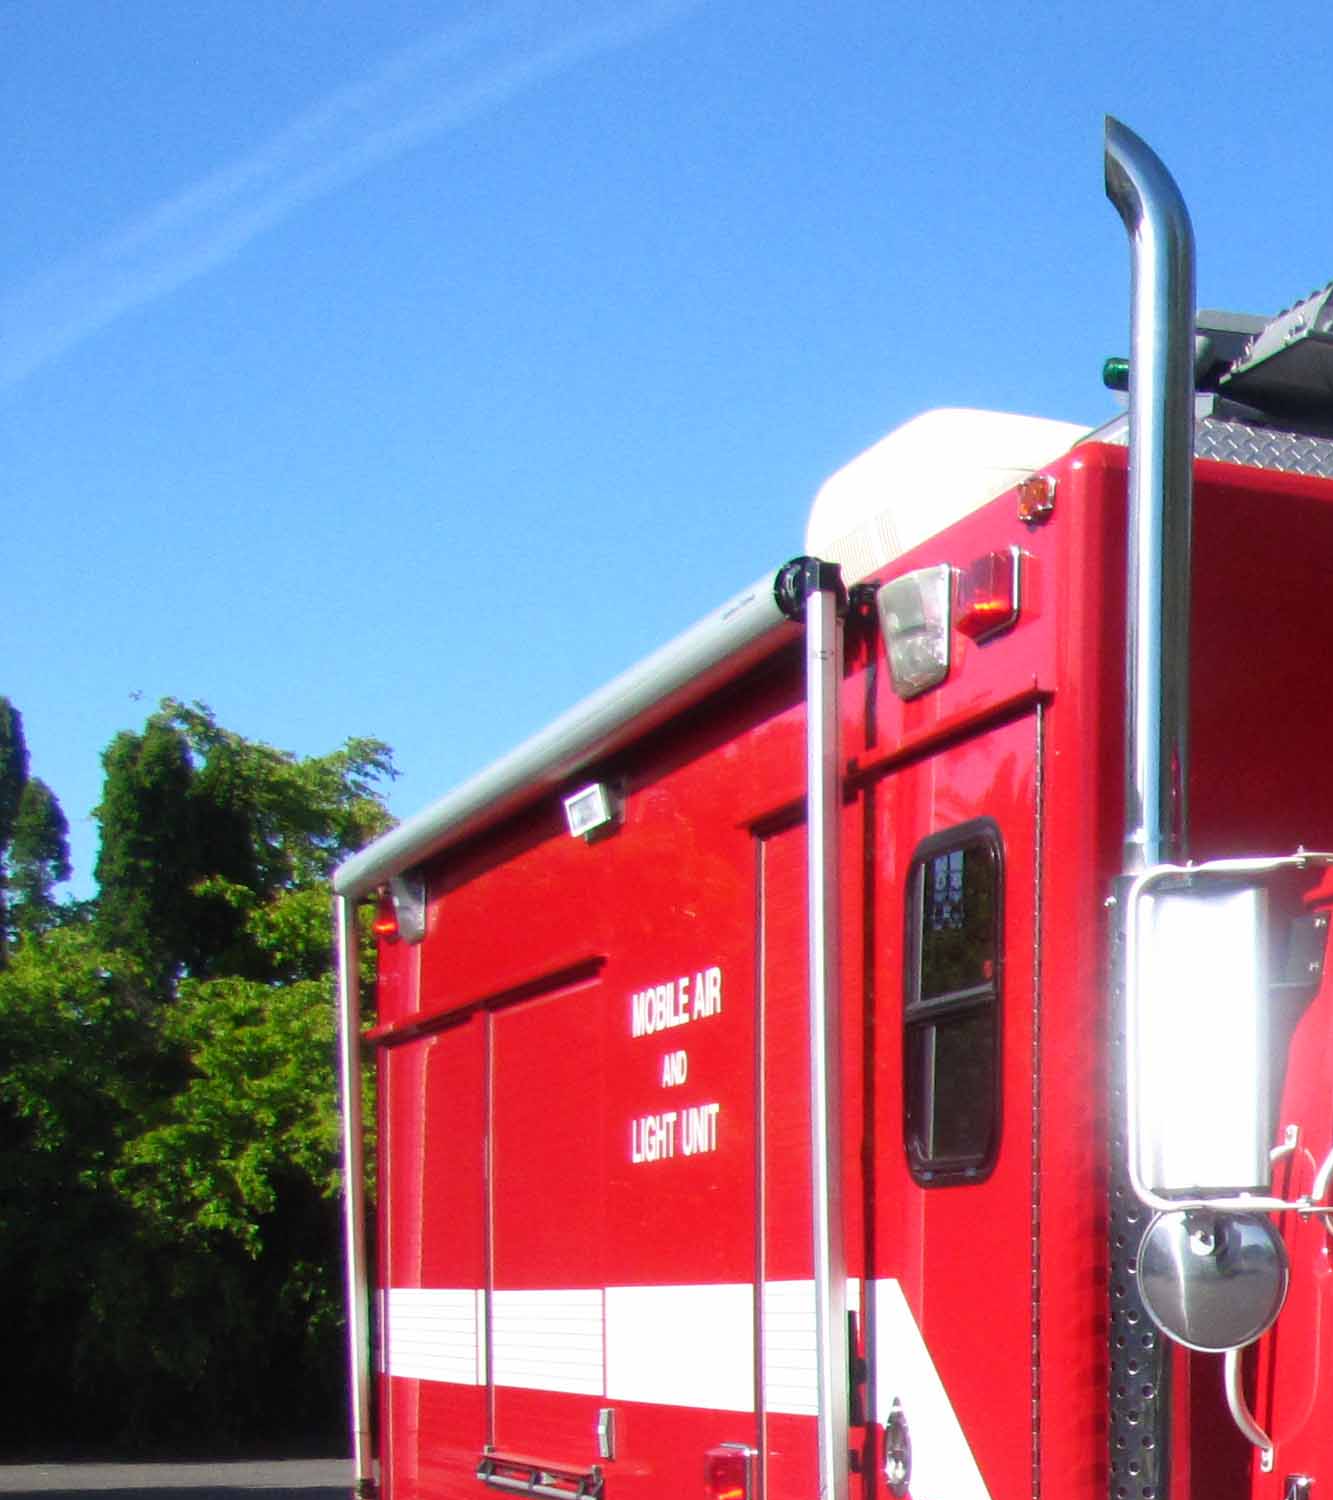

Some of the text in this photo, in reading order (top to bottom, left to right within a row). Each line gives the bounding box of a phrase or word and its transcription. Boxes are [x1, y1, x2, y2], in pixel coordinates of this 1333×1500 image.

[632, 966, 721, 1038] MOBILE AIR
[662, 1050, 687, 1088] AND
[631, 1103, 720, 1164] LIGHT UNIT
